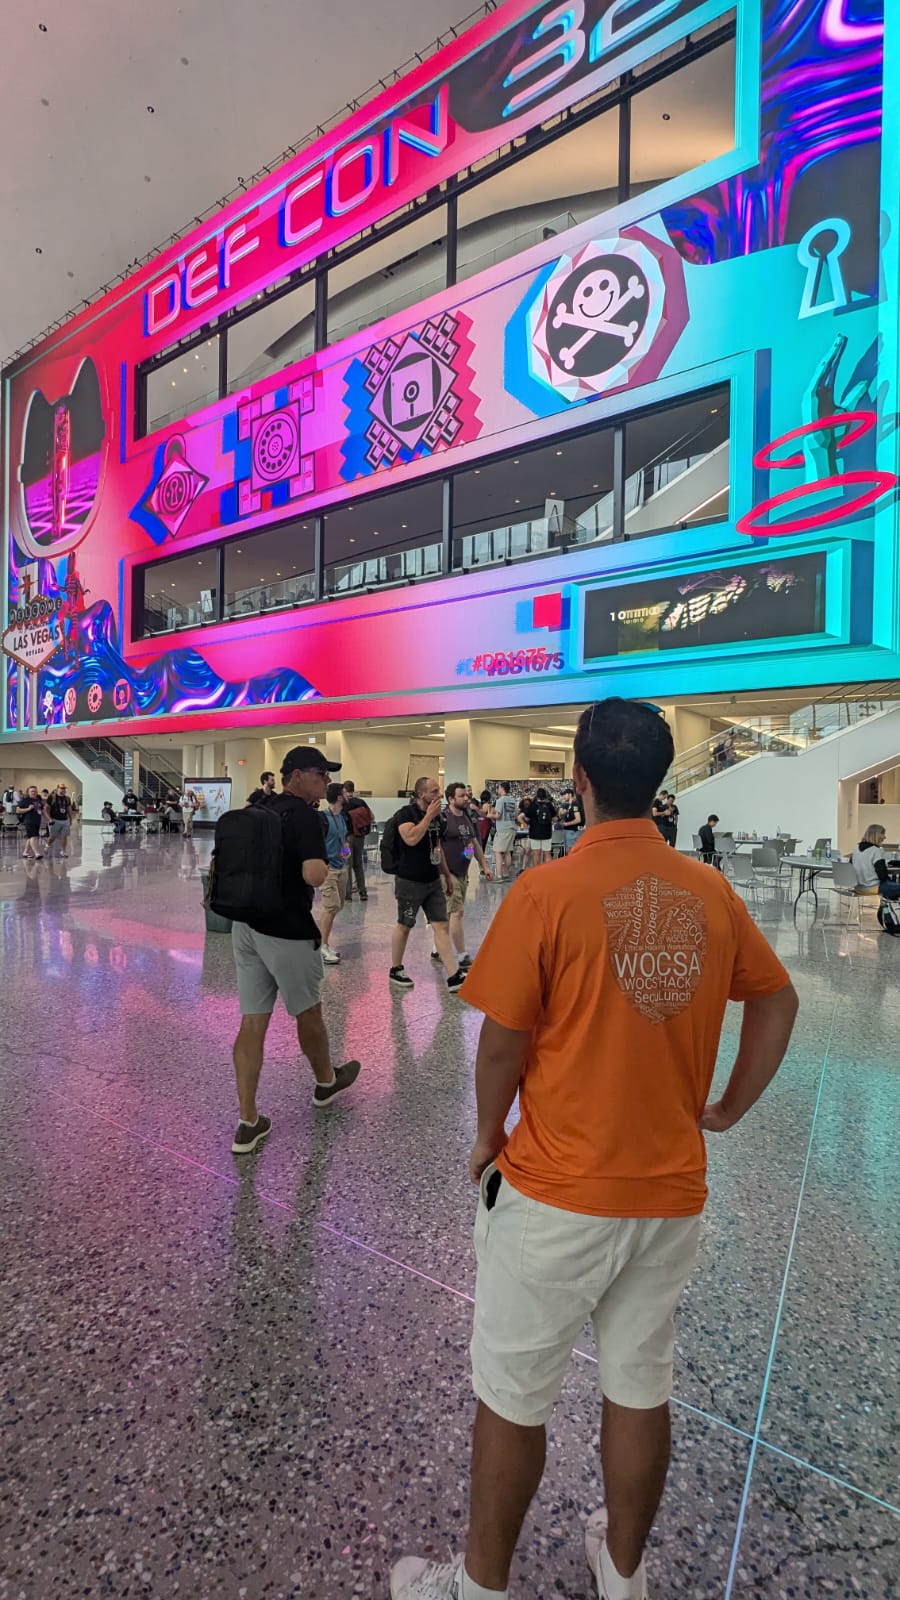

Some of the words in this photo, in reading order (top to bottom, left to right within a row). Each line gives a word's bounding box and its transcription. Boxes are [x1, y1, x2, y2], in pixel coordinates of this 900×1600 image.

[144, 222, 260, 338] DEF
[280, 83, 448, 248] CON
[14, 635, 28, 651] LAS
[31, 624, 60, 646] VEGAS
[645, 876, 660, 945] Cyberjutsu
[614, 951, 701, 978] WOCSA
[624, 976, 691, 991] WOCSHACK
[634, 990, 692, 1004] SecuLunch
